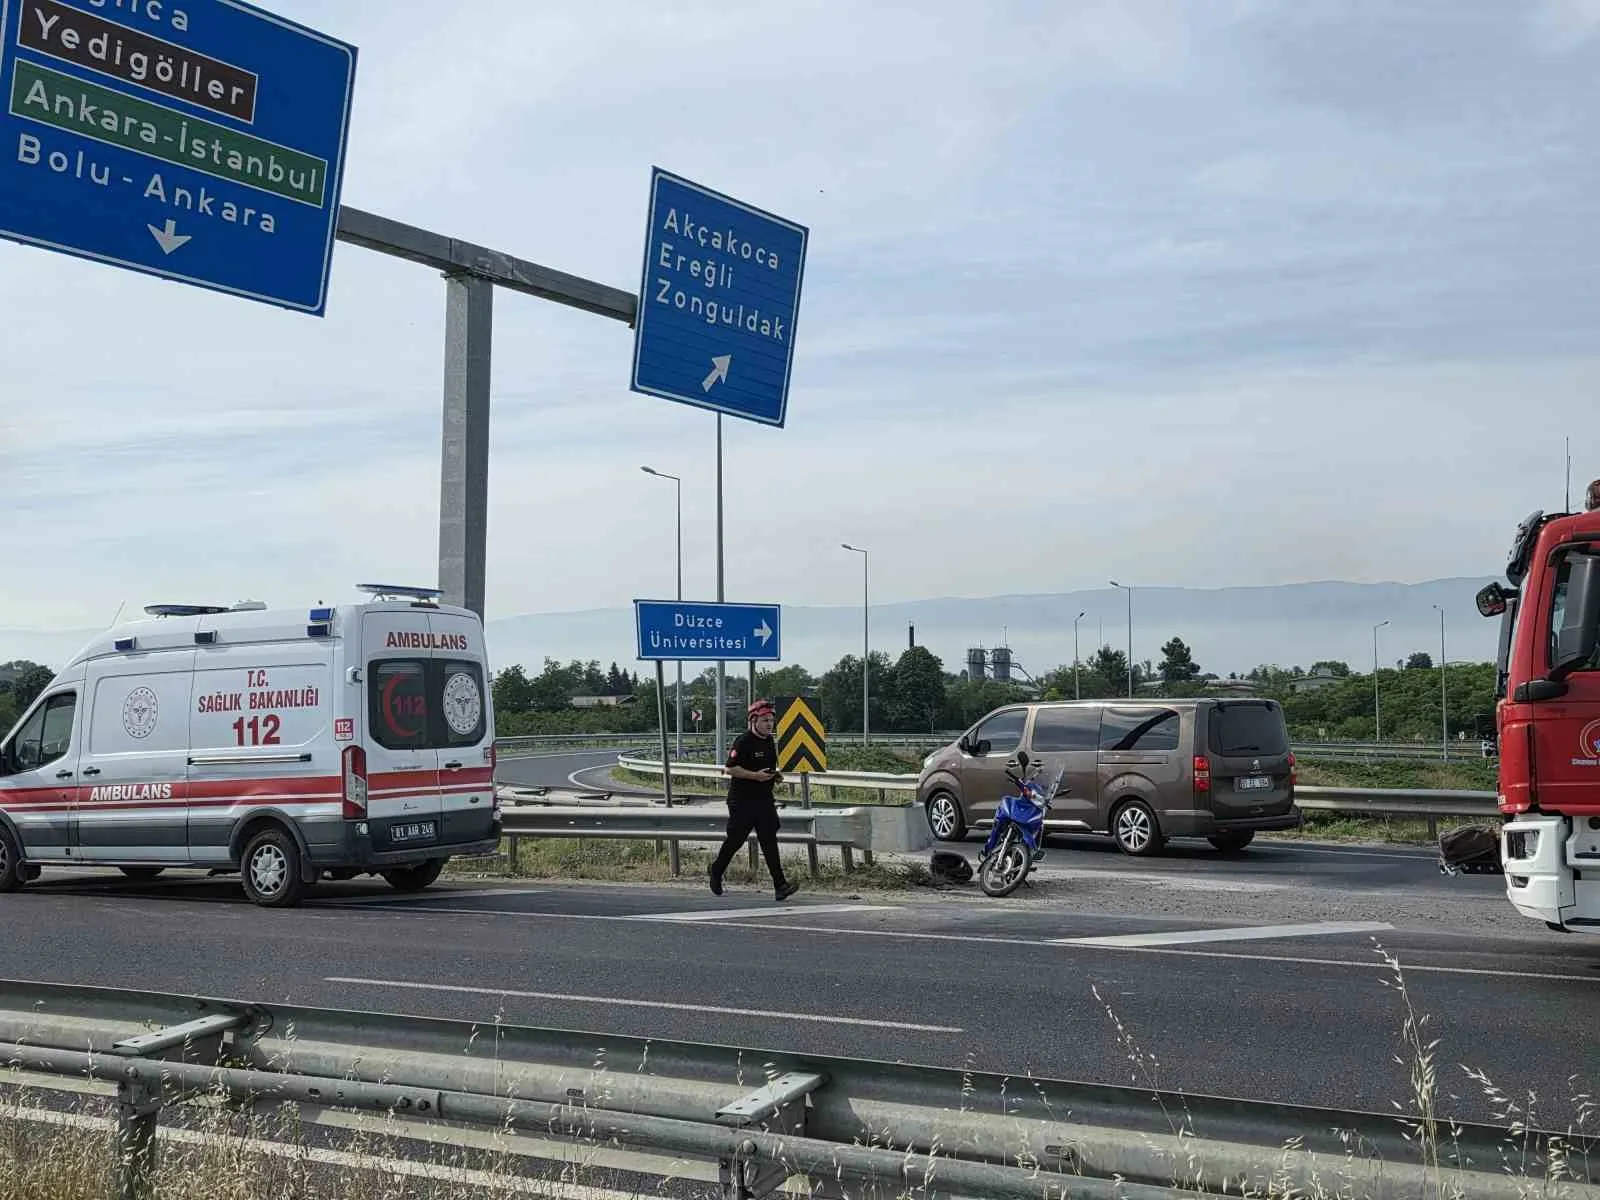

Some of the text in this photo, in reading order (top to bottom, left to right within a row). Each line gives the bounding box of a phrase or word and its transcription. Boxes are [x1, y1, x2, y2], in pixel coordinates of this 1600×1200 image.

[35, 8, 244, 105] Yedigöller
[18, 133, 110, 187] Bolu
[144, 174, 276, 234] Ankara
[664, 208, 779, 270] Akçakoca
[659, 242, 733, 289] Ereğli
[656, 278, 785, 341] Zonguldak
[674, 613, 723, 628] Düzce
[386, 631, 468, 650] AMBULANS
[650, 630, 747, 649] Üniversitesi
[247, 670, 269, 688] T.C.
[198, 684, 319, 713] SAĞLIK BAKANLIĞI
[393, 695, 426, 716] 112
[232, 713, 281, 747] 112
[336, 721, 351, 733] 112
[90, 783, 172, 801] AMBULANS
